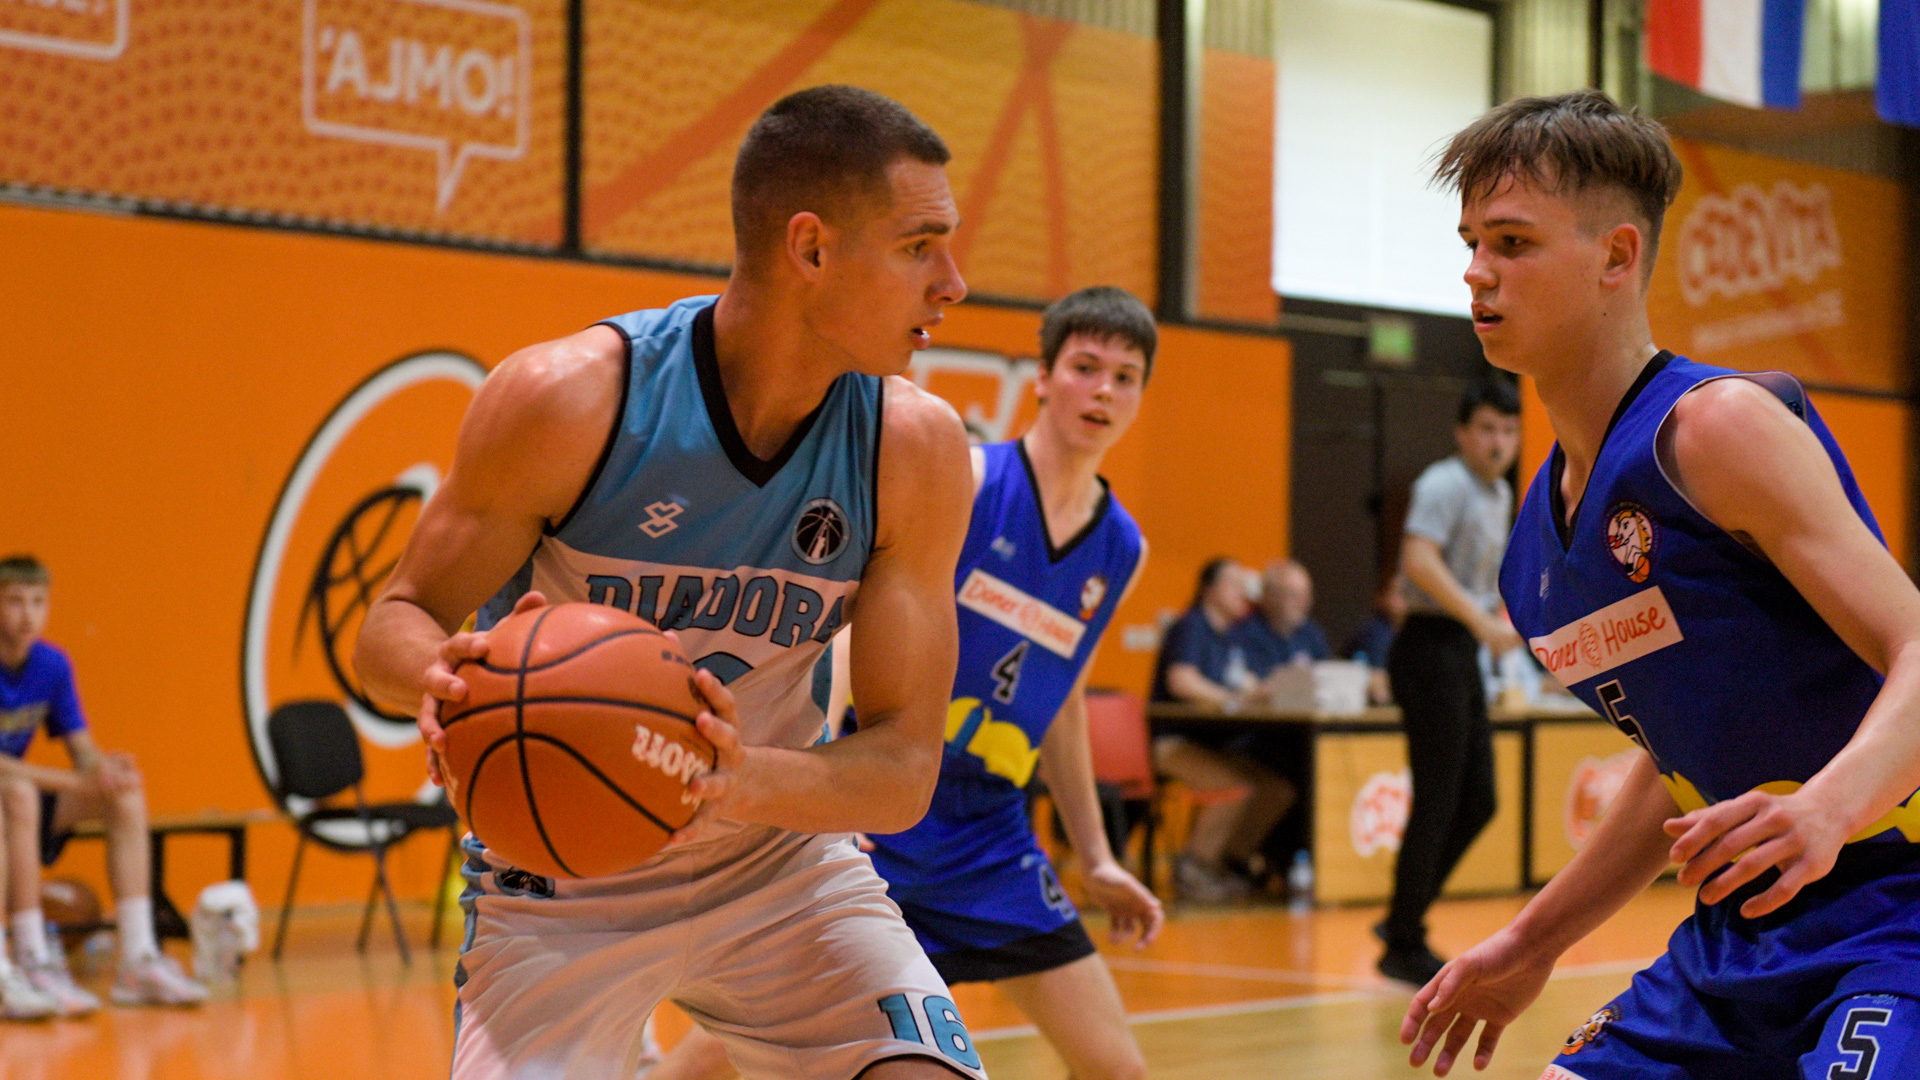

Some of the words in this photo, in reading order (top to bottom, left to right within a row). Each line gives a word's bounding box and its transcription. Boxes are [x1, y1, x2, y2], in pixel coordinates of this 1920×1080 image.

[586, 573, 846, 648] DIADORA
[1601, 606, 1667, 657] House
[990, 640, 1030, 704] 4
[877, 992, 981, 1070] 16
[1826, 1007, 1893, 1080] 5
